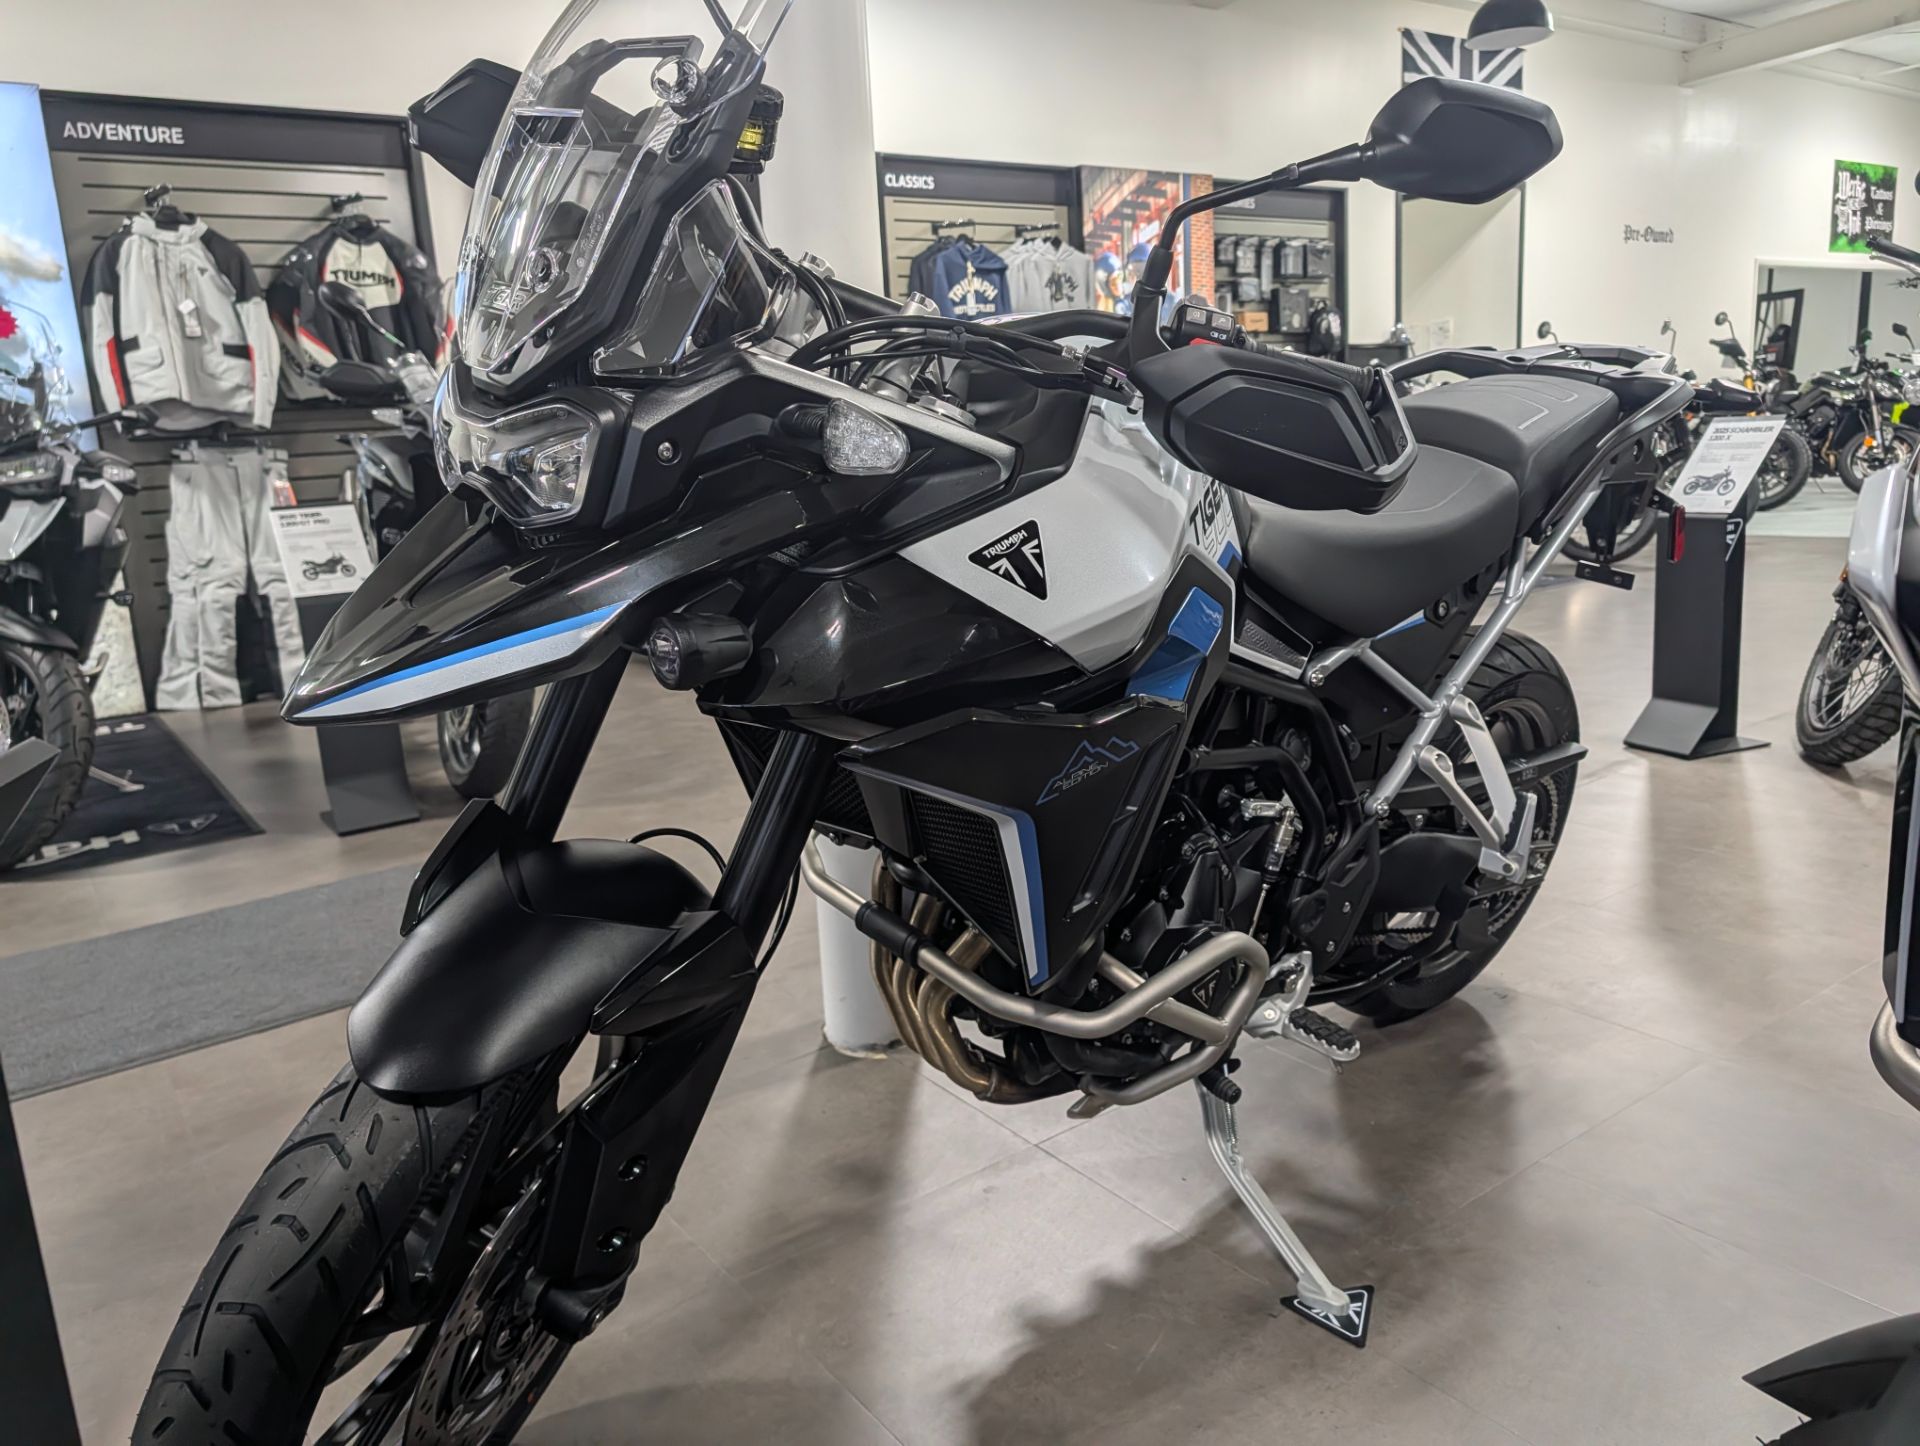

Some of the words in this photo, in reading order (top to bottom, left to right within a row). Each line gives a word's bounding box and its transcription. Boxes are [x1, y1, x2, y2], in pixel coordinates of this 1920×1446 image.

[63, 121, 185, 145] ADVENTURE
[884, 172, 936, 190] CLASSICS
[1623, 223, 1674, 244] Pre-Owned
[330, 268, 396, 288] TRIUMPH
[982, 529, 1028, 559] TRIUMPH
[1052, 760, 1099, 790] ALPINE
[1062, 760, 1109, 791] EDITION
